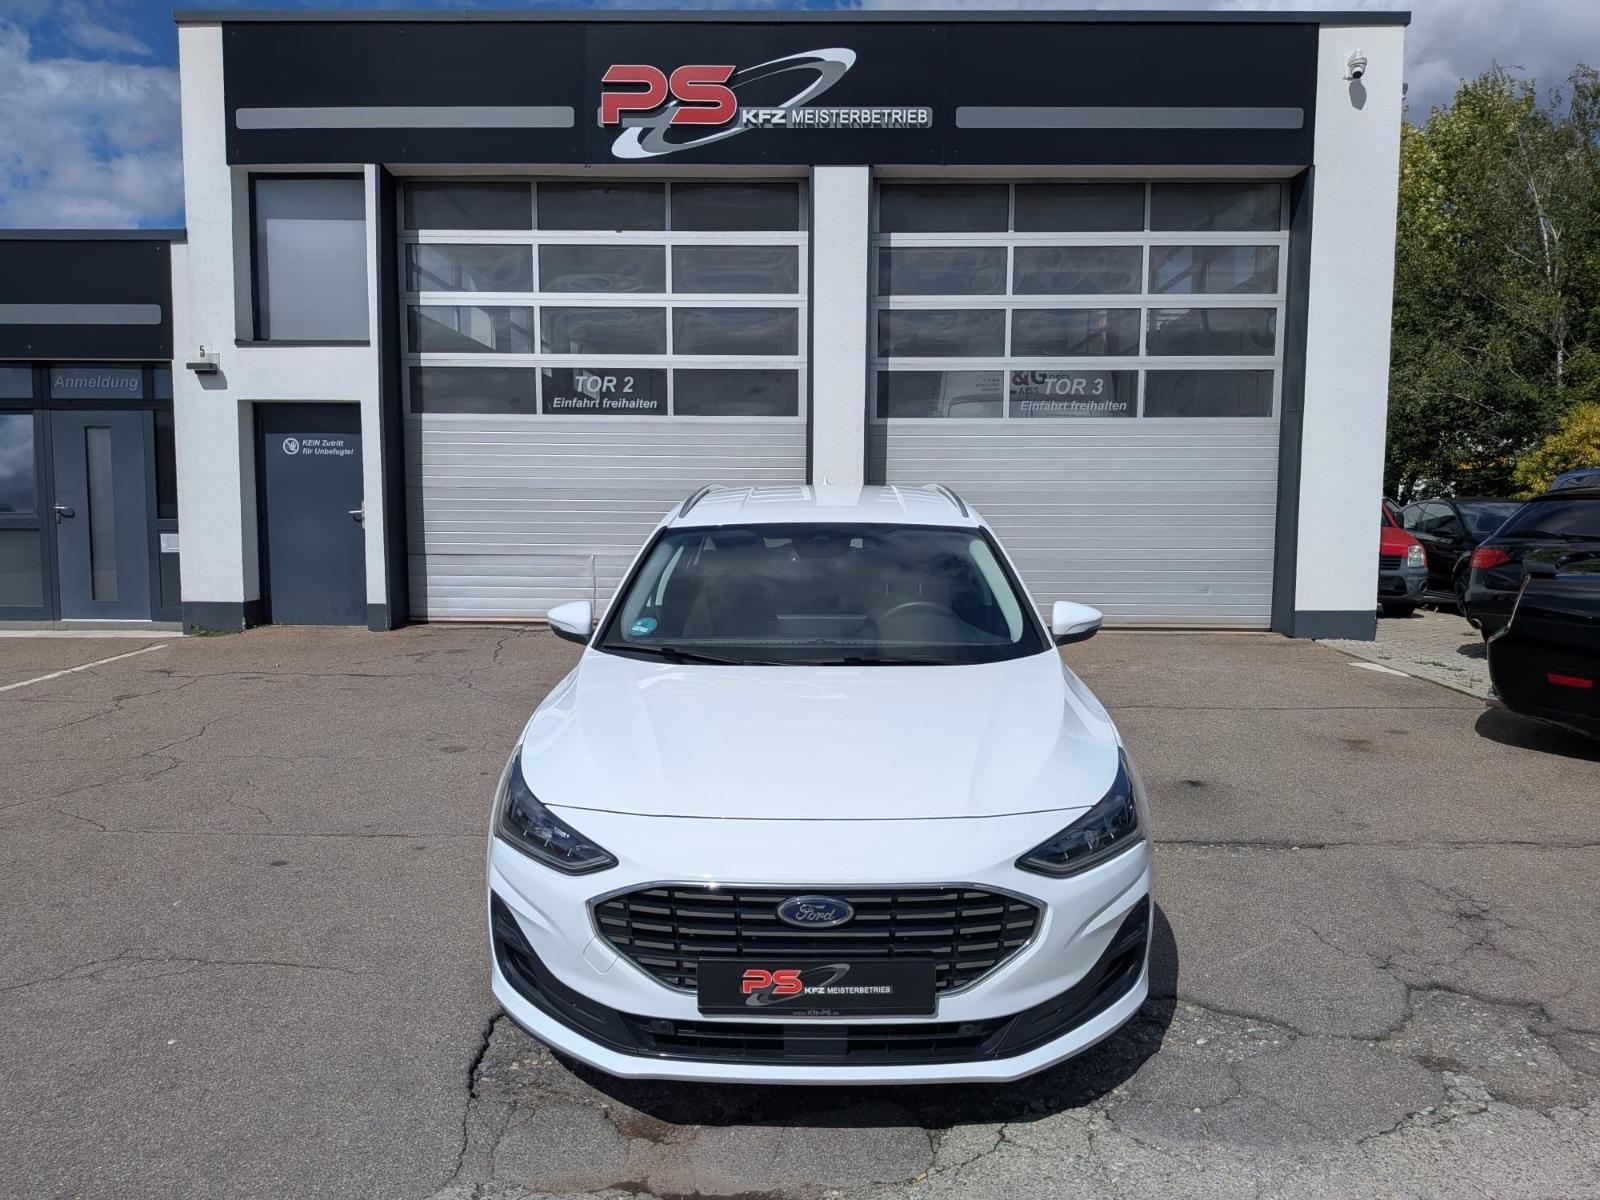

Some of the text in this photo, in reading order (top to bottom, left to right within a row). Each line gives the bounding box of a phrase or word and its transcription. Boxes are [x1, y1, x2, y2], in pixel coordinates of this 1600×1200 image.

[601, 65, 929, 125] PS KFZ MEISTERBETRIEB
[199, 345, 206, 358] 5
[53, 375, 139, 392] Anmeldung
[575, 376, 634, 393] TOR 2
[1044, 378, 1087, 395] TOR
[1092, 378, 1104, 395] 3
[552, 397, 658, 410] Einfahrt freihalten
[1020, 400, 1127, 412] Einfahrt freihalten
[302, 439, 344, 447] KEIN Zutritt
[302, 447, 313, 455] für
[795, 903, 836, 921] Ford
[742, 969, 892, 995] PS KFZ MEISTERBETRIEB
